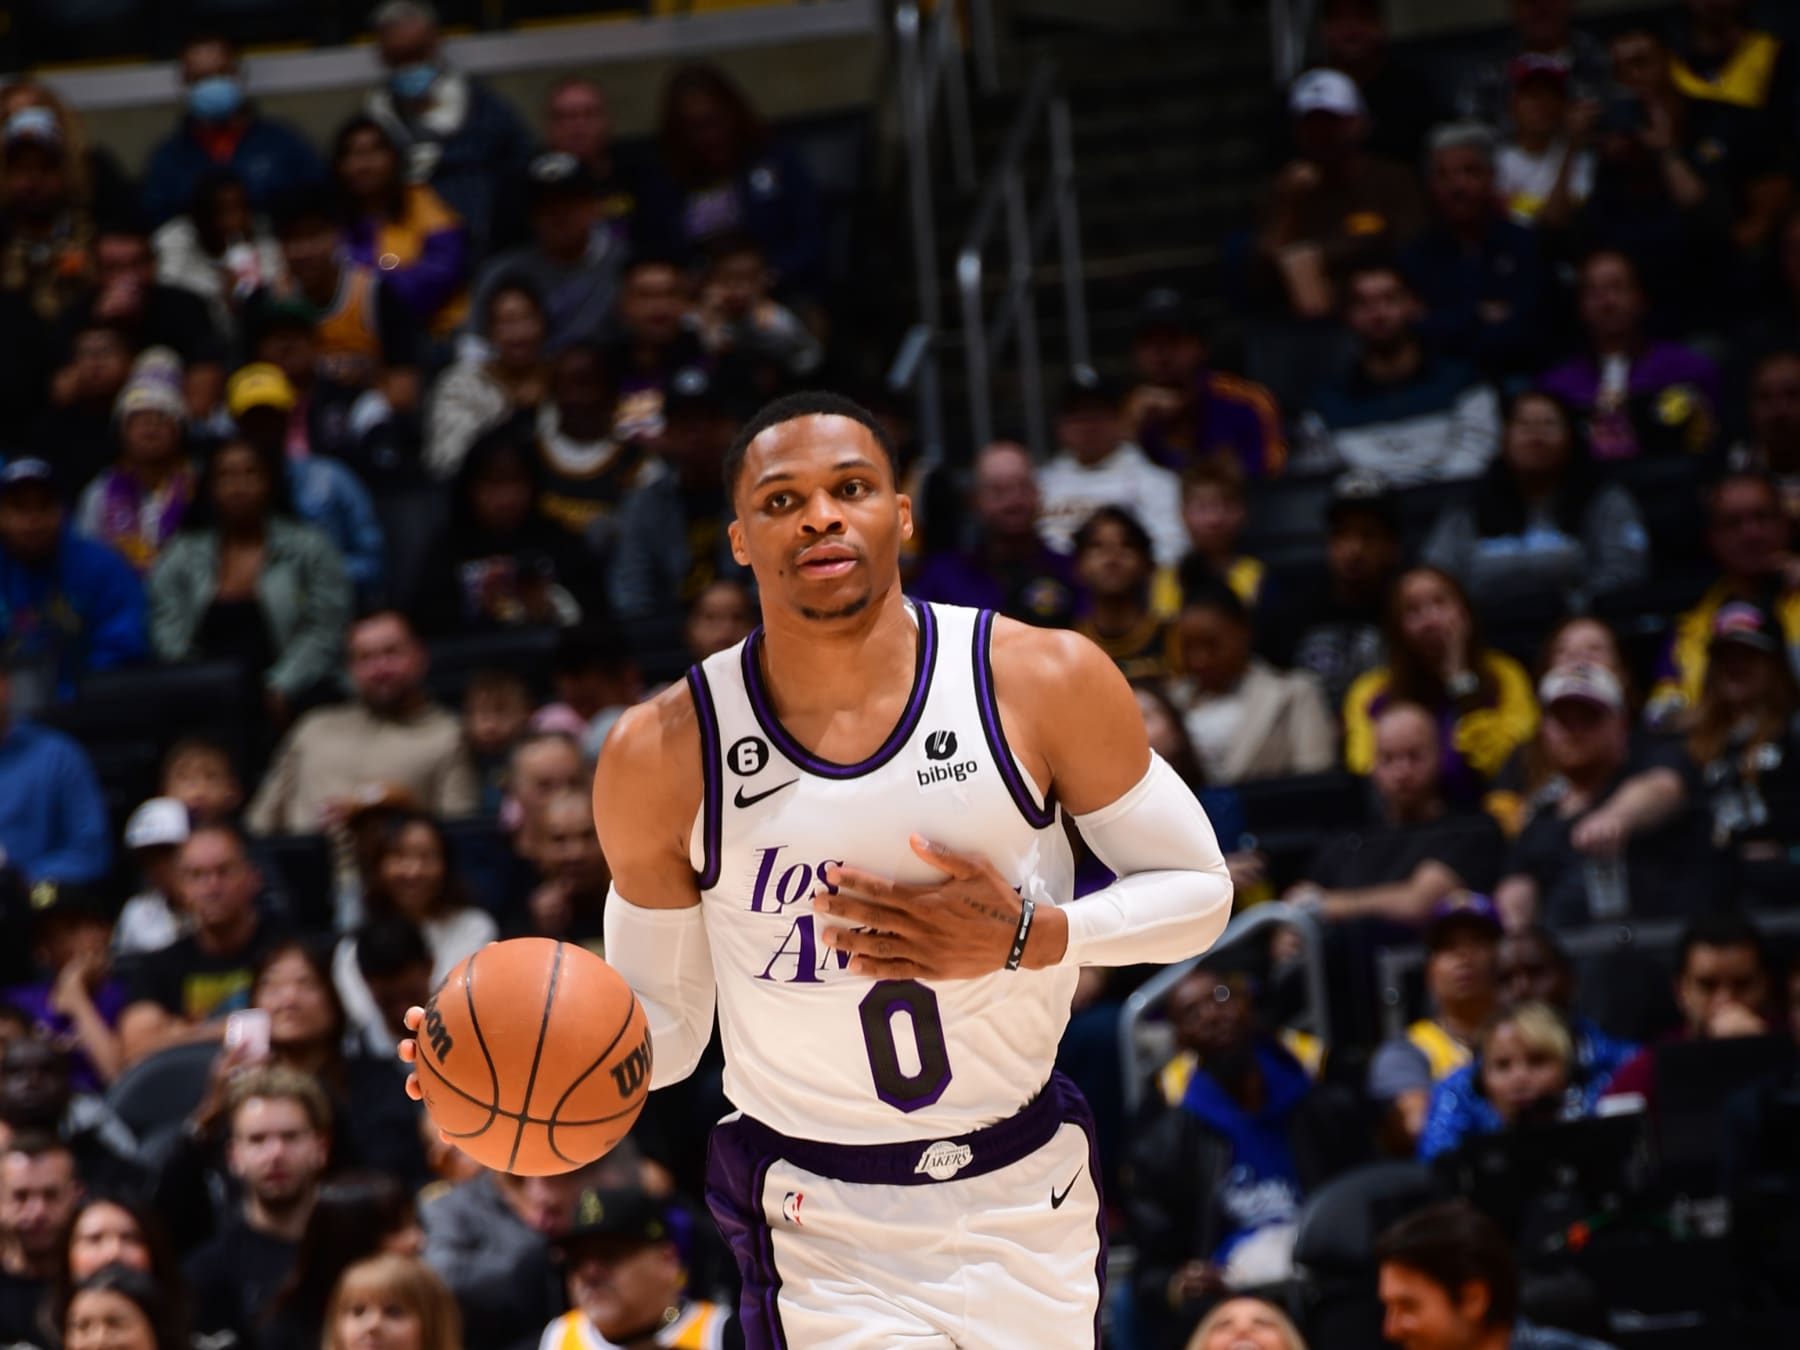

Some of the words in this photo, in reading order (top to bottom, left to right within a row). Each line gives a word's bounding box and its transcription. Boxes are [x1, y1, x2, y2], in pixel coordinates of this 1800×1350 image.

[917, 760, 978, 787] bibigo
[858, 979, 953, 1114] 0
[917, 1149, 971, 1172] LAKERS
